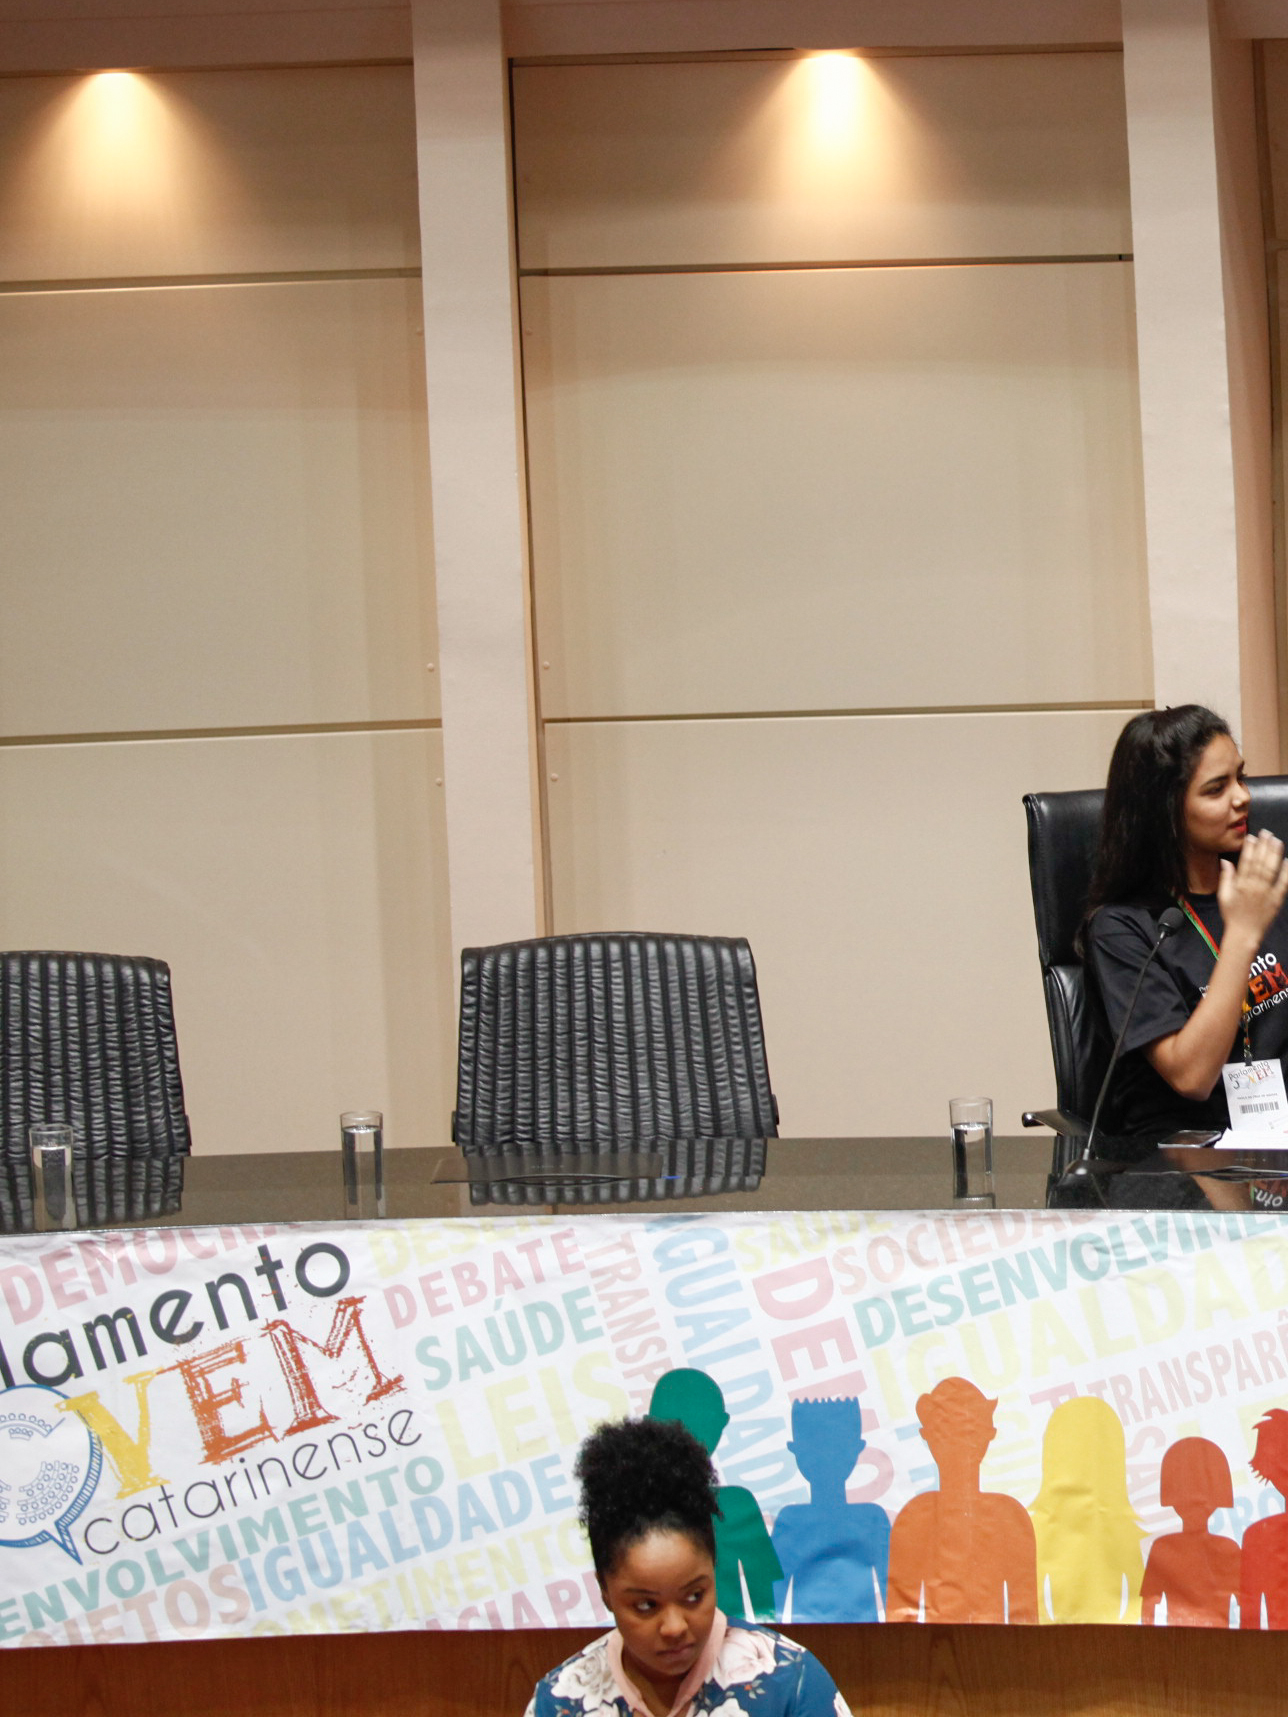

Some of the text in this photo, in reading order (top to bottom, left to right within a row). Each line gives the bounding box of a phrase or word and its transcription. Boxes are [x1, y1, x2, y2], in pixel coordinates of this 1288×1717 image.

[383, 1228, 586, 1330] DEBATE
[415, 1286, 604, 1391] SAÚDE
[436, 1351, 629, 1480] LEIS
[83, 1409, 422, 1555] catarinense
[238, 1454, 576, 1612] IGUALDADE
